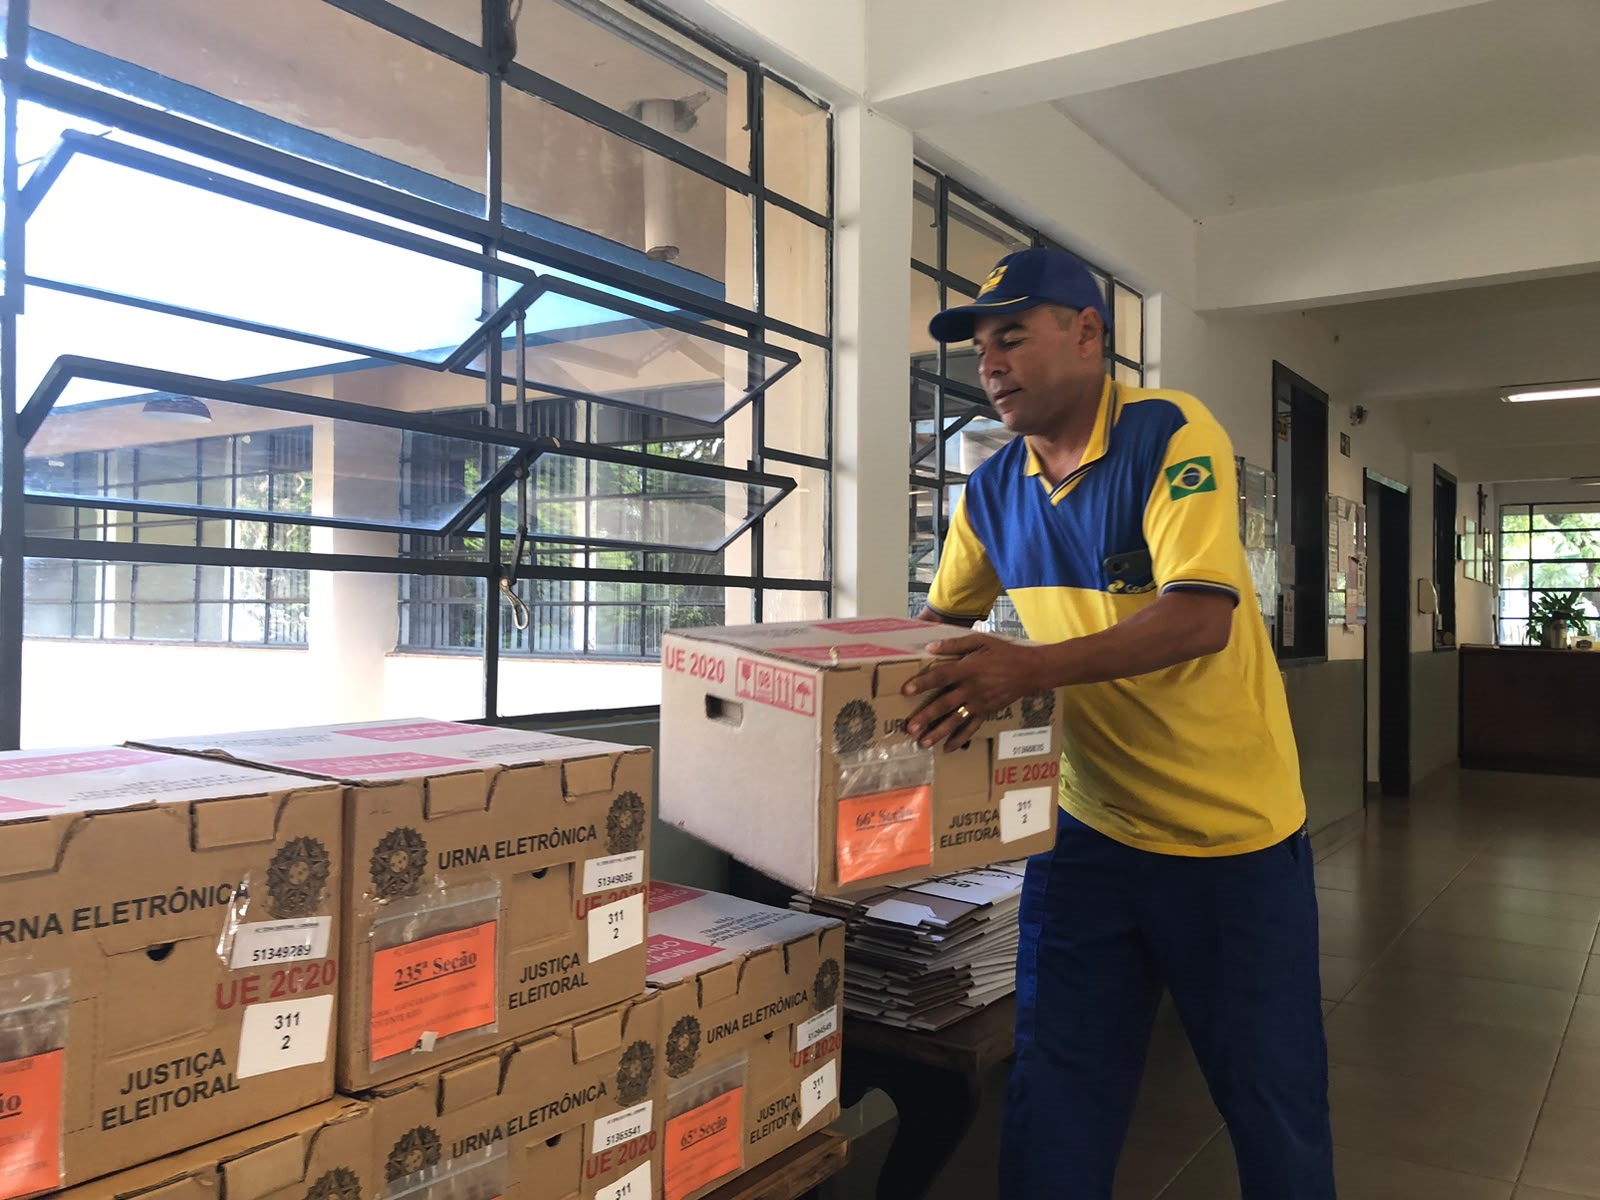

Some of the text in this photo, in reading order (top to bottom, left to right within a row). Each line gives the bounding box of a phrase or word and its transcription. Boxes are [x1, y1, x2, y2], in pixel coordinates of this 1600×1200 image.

[665, 645, 725, 684] UE 2020
[995, 761, 1058, 785] UE 2020
[948, 808, 1000, 829] JUSTIÇA
[1016, 800, 1032, 812] 311
[1021, 814, 1028, 824] 2
[438, 824, 598, 870] URNA ELETRÔNICA
[940, 825, 1001, 849] ELEITORA
[72, 881, 249, 933] ELETRÔNICA
[607, 910, 624, 925] 311
[613, 928, 619, 940] 2
[432, 951, 477, 975] Seção
[519, 952, 580, 984] JUSTIÇA
[216, 975, 260, 1010] UE
[269, 959, 337, 999] 2020
[508, 972, 589, 1010] ELEITORAL
[274, 1012, 300, 1030] 311
[707, 1019, 740, 1044] URNA
[742, 989, 809, 1030] ELETRÔNICA
[280, 1035, 291, 1050] 2
[814, 1032, 841, 1059] 2020
[120, 1048, 226, 1096] JUSTIÇA
[813, 1075, 824, 1090] 311
[101, 1072, 241, 1132] ELEITORAL
[757, 1093, 797, 1122] JUSTIÇA
[817, 1090, 821, 1100] 2
[452, 1080, 608, 1158] URNA ELETRÔNICA
[586, 1150, 612, 1180] UE
[617, 1130, 657, 1166] 2020
[615, 1182, 631, 1200] 311
